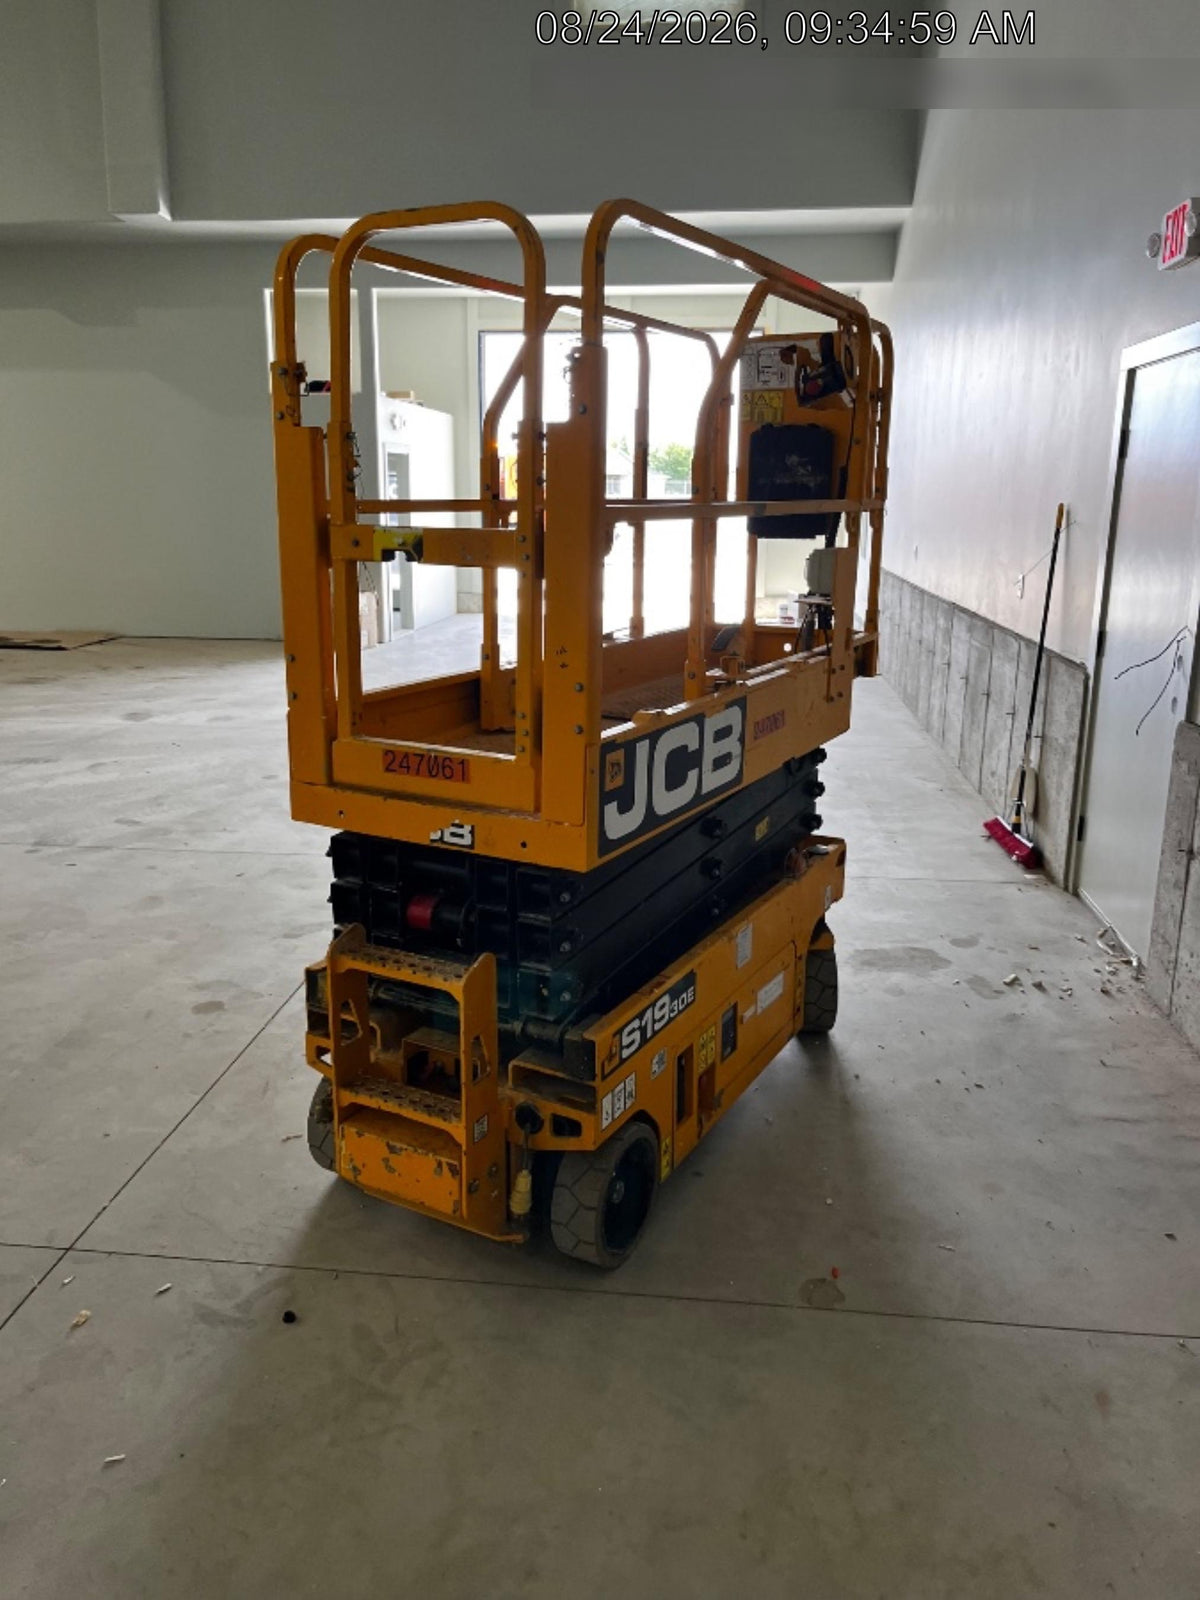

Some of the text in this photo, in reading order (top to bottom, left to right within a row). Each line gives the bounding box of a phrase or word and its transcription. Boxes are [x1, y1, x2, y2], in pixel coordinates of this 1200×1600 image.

[1163, 203, 1188, 263] EXIT
[384, 750, 466, 782] 247061
[604, 705, 742, 840] JCB
